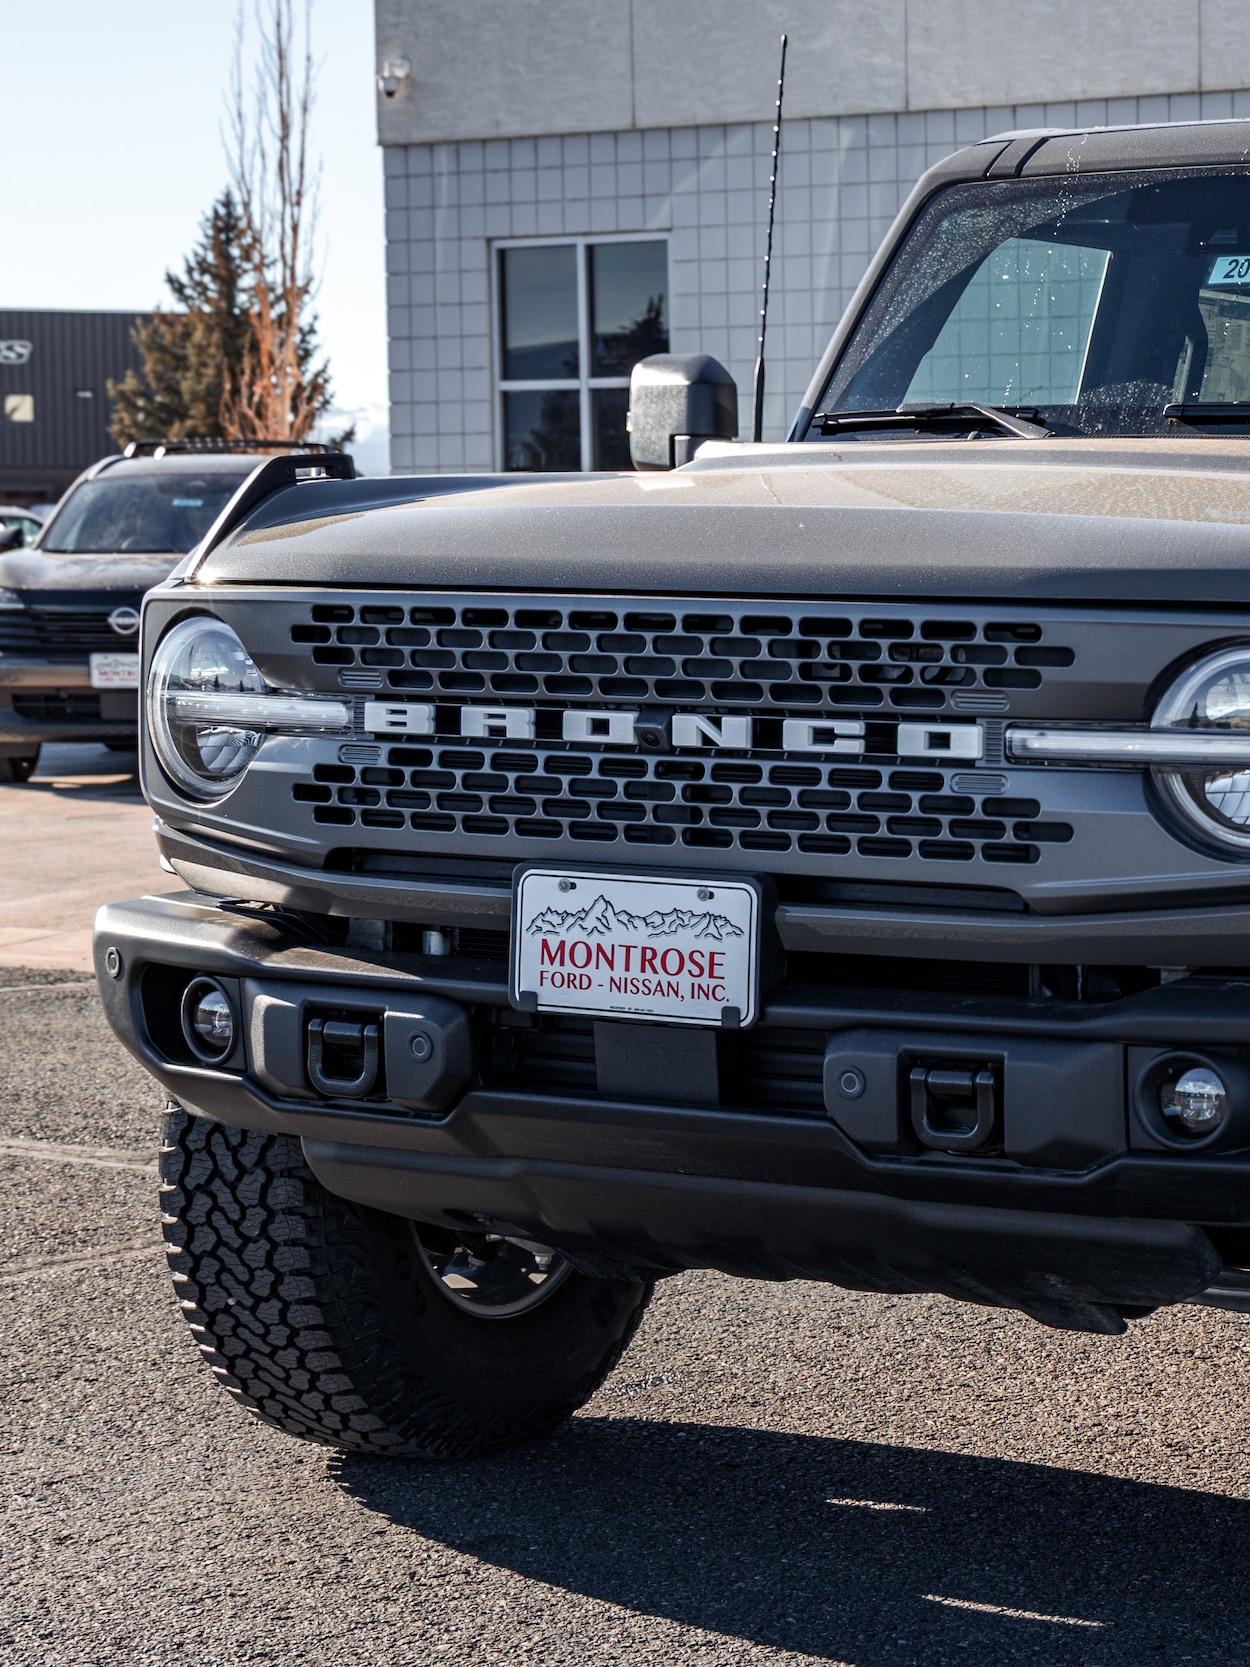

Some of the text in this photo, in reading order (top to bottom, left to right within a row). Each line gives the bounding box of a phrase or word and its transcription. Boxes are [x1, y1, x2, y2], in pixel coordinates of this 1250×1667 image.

[364, 701, 984, 760] BRONCO
[539, 938, 726, 980] MONTROSE
[539, 970, 592, 991] FORD
[609, 976, 685, 1002] NISSAN,
[690, 982, 730, 1002] INC.
